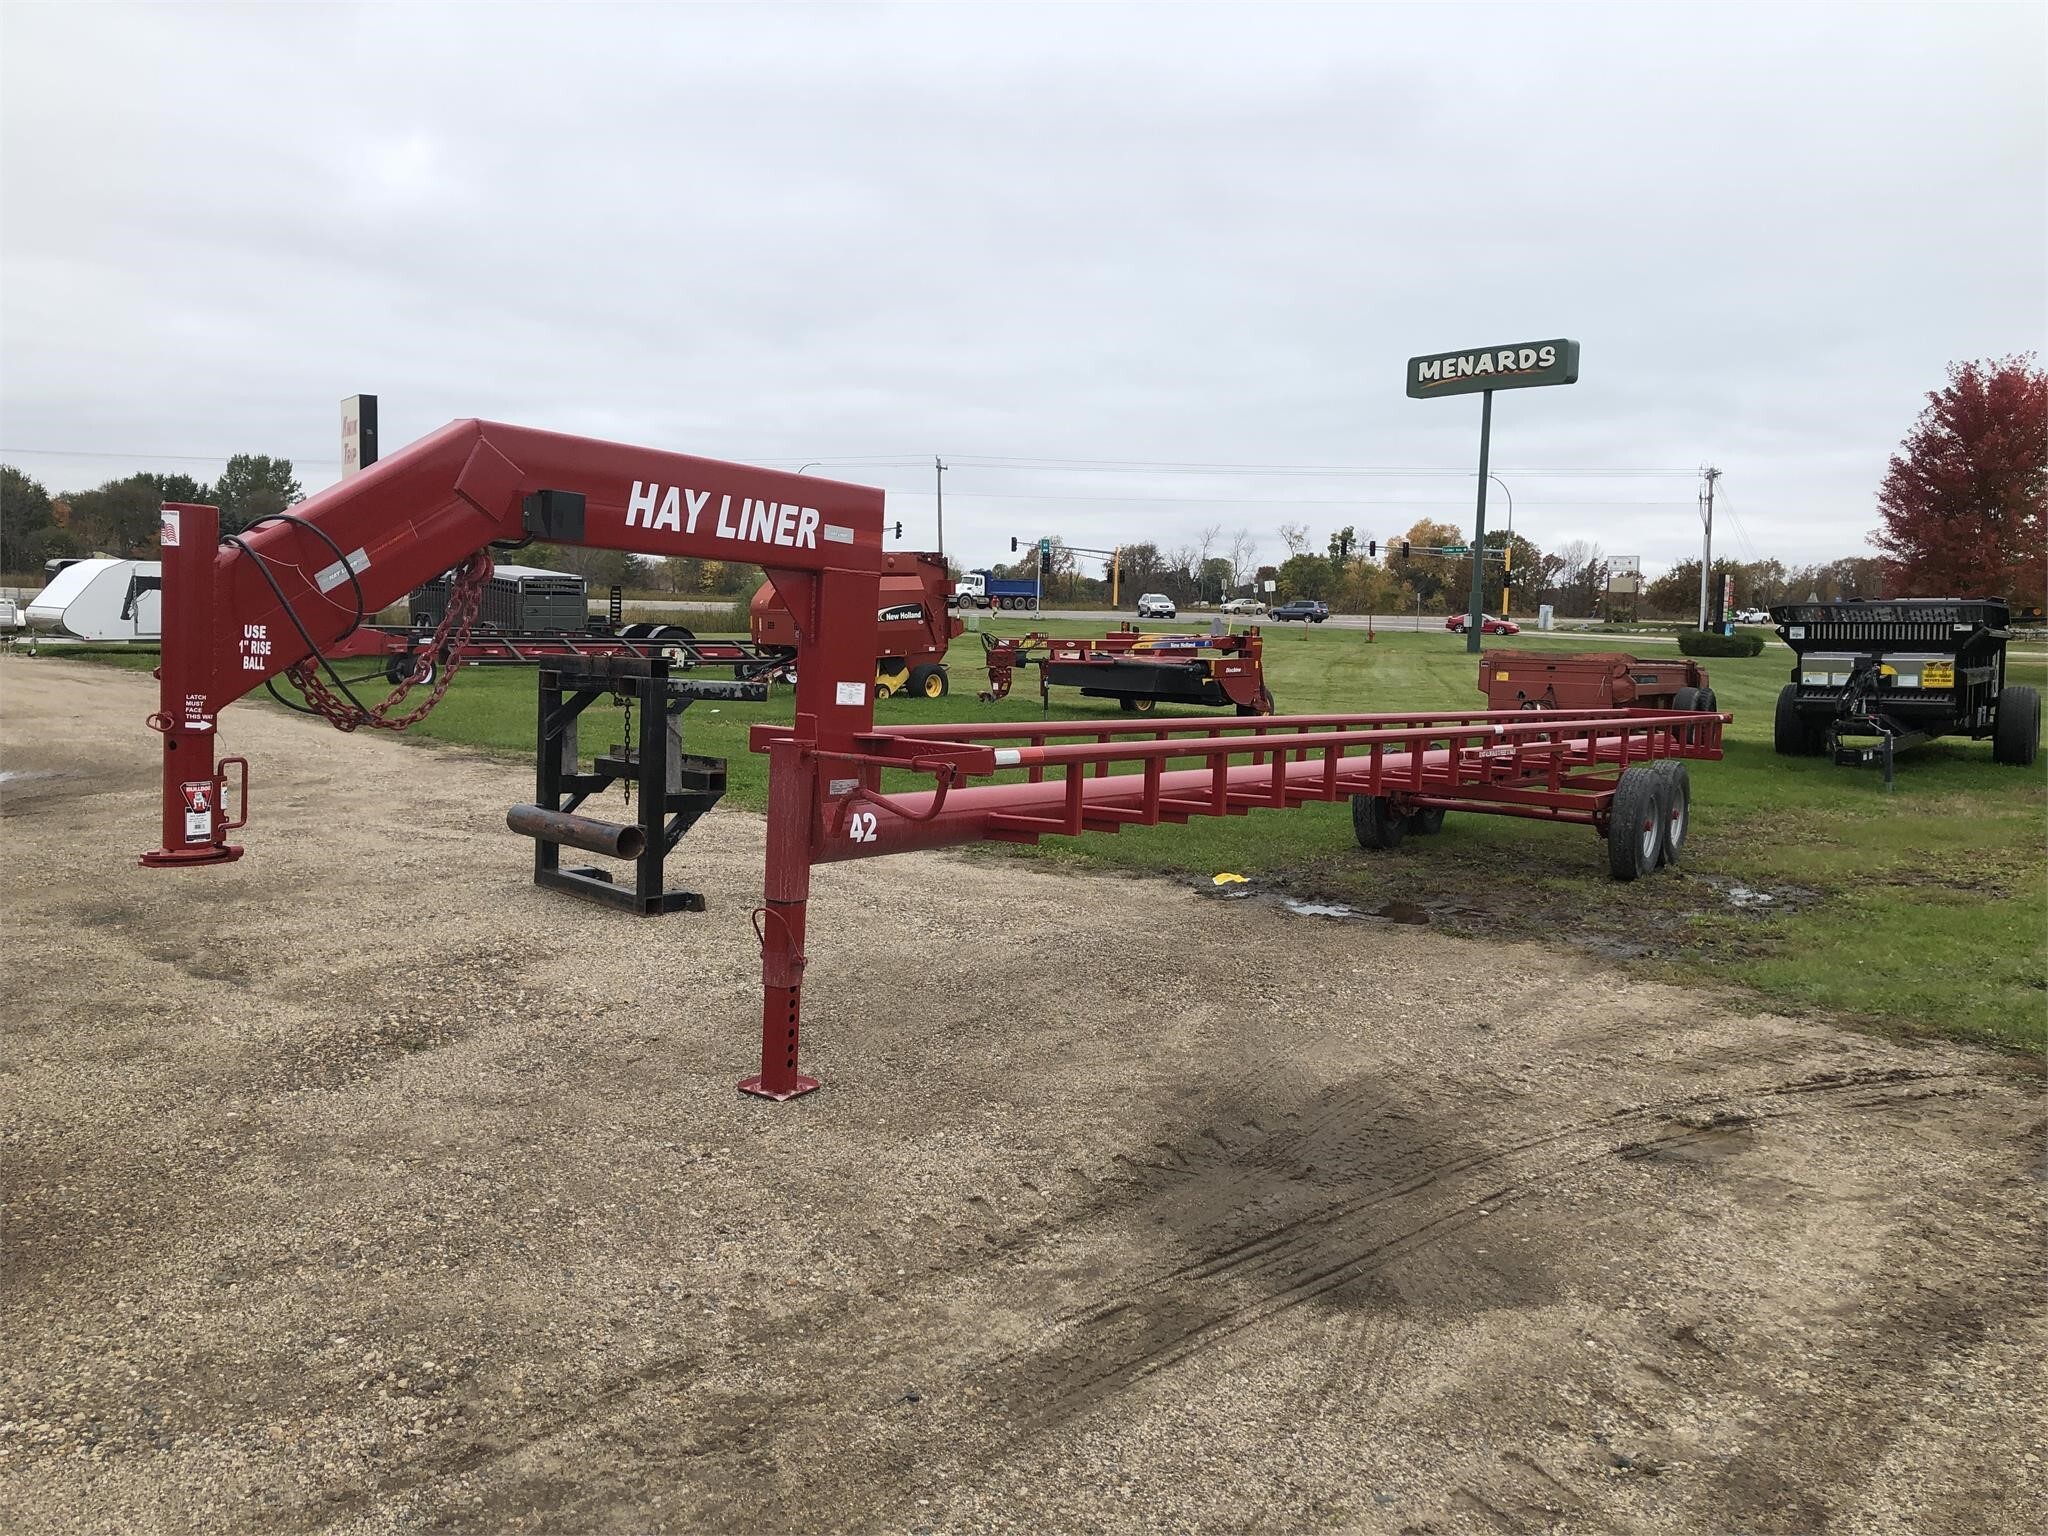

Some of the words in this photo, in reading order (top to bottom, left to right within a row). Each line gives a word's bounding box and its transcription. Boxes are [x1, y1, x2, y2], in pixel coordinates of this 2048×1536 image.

[1417, 345, 1556, 382] MENARDS
[625, 480, 711, 534] HAY
[716, 494, 820, 549] LINER
[886, 612, 900, 620] New
[900, 610, 922, 619] Holland
[244, 624, 267, 639] USE
[238, 639, 249, 654] 1"
[250, 640, 272, 655] RISE
[243, 655, 266, 670] BALL
[850, 812, 877, 843] 42
